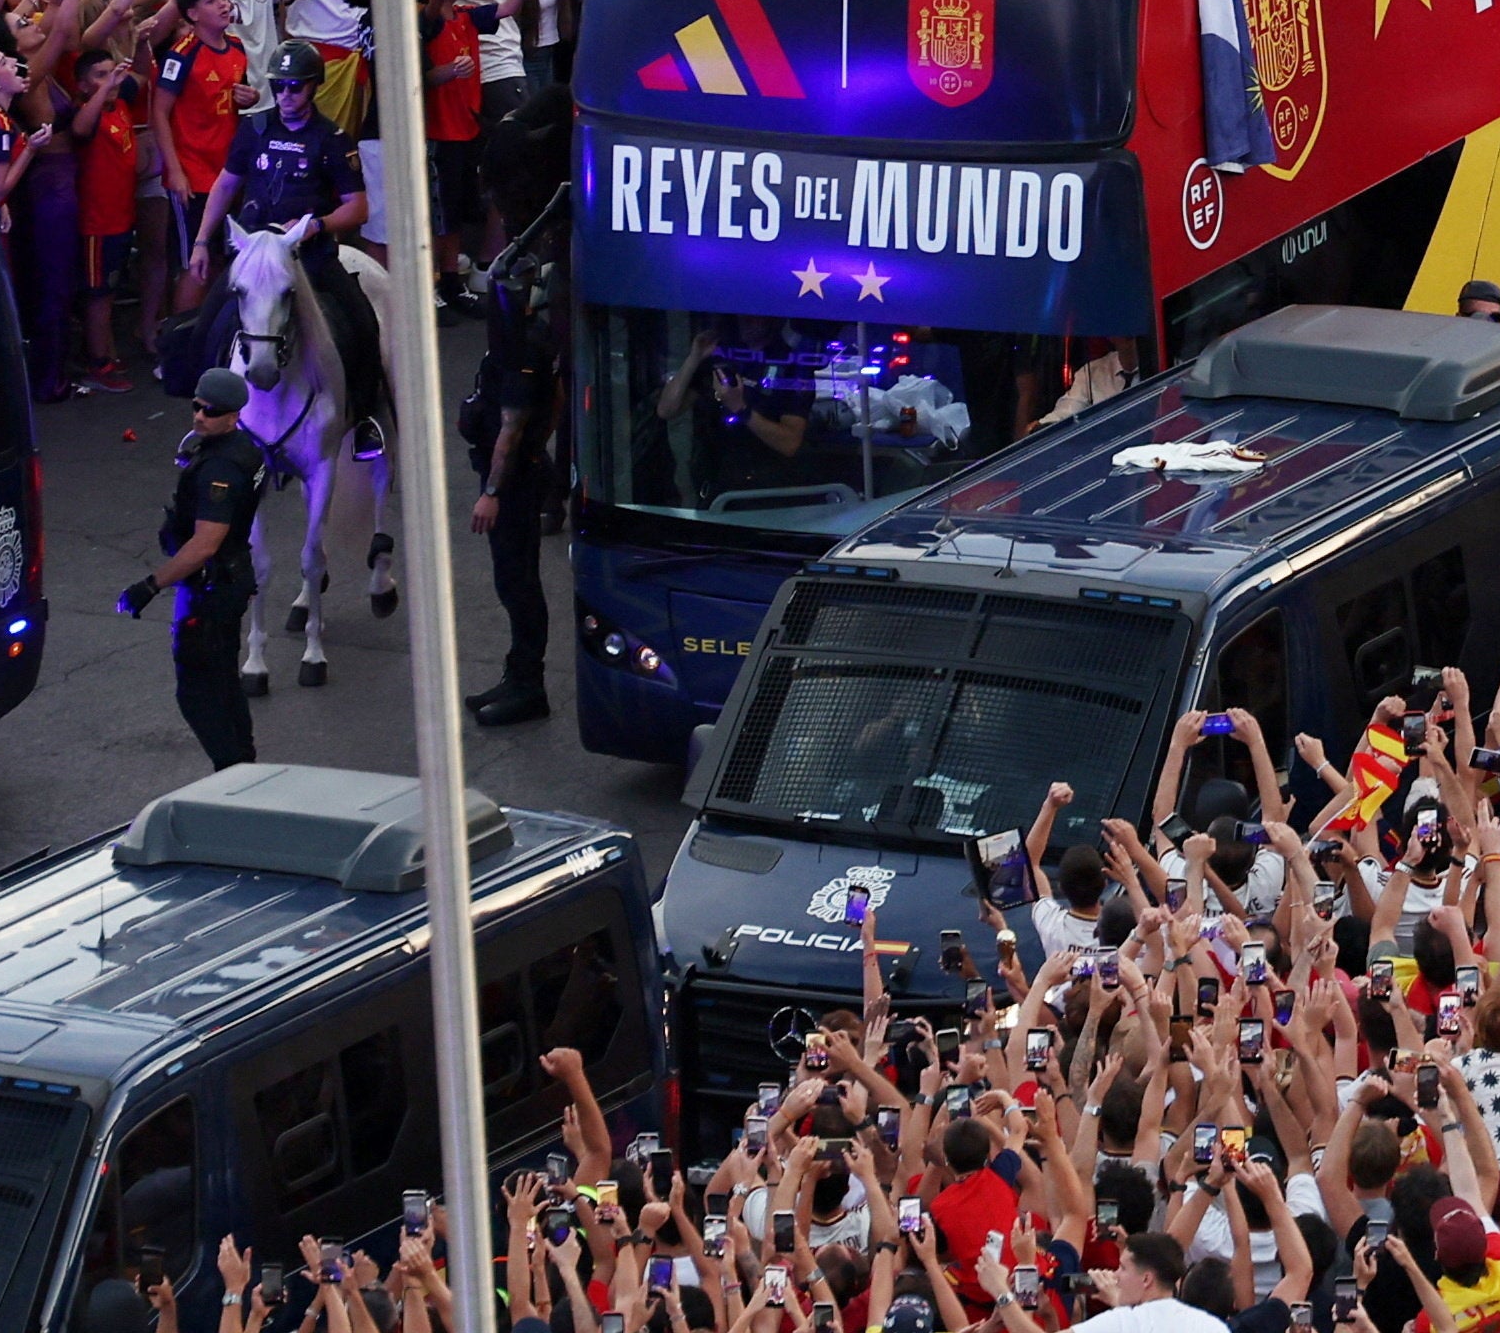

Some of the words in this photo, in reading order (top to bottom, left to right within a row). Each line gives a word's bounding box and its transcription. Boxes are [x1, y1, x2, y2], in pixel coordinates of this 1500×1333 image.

[1277, 106, 1293, 125] RF
[1279, 119, 1294, 140] EF
[1190, 169, 1213, 201] RF
[611, 144, 781, 242] REYES
[794, 174, 842, 222] DEL
[847, 160, 1084, 261] MUNDO
[1192, 200, 1215, 230] EF
[734, 925, 866, 953] POLICIA
